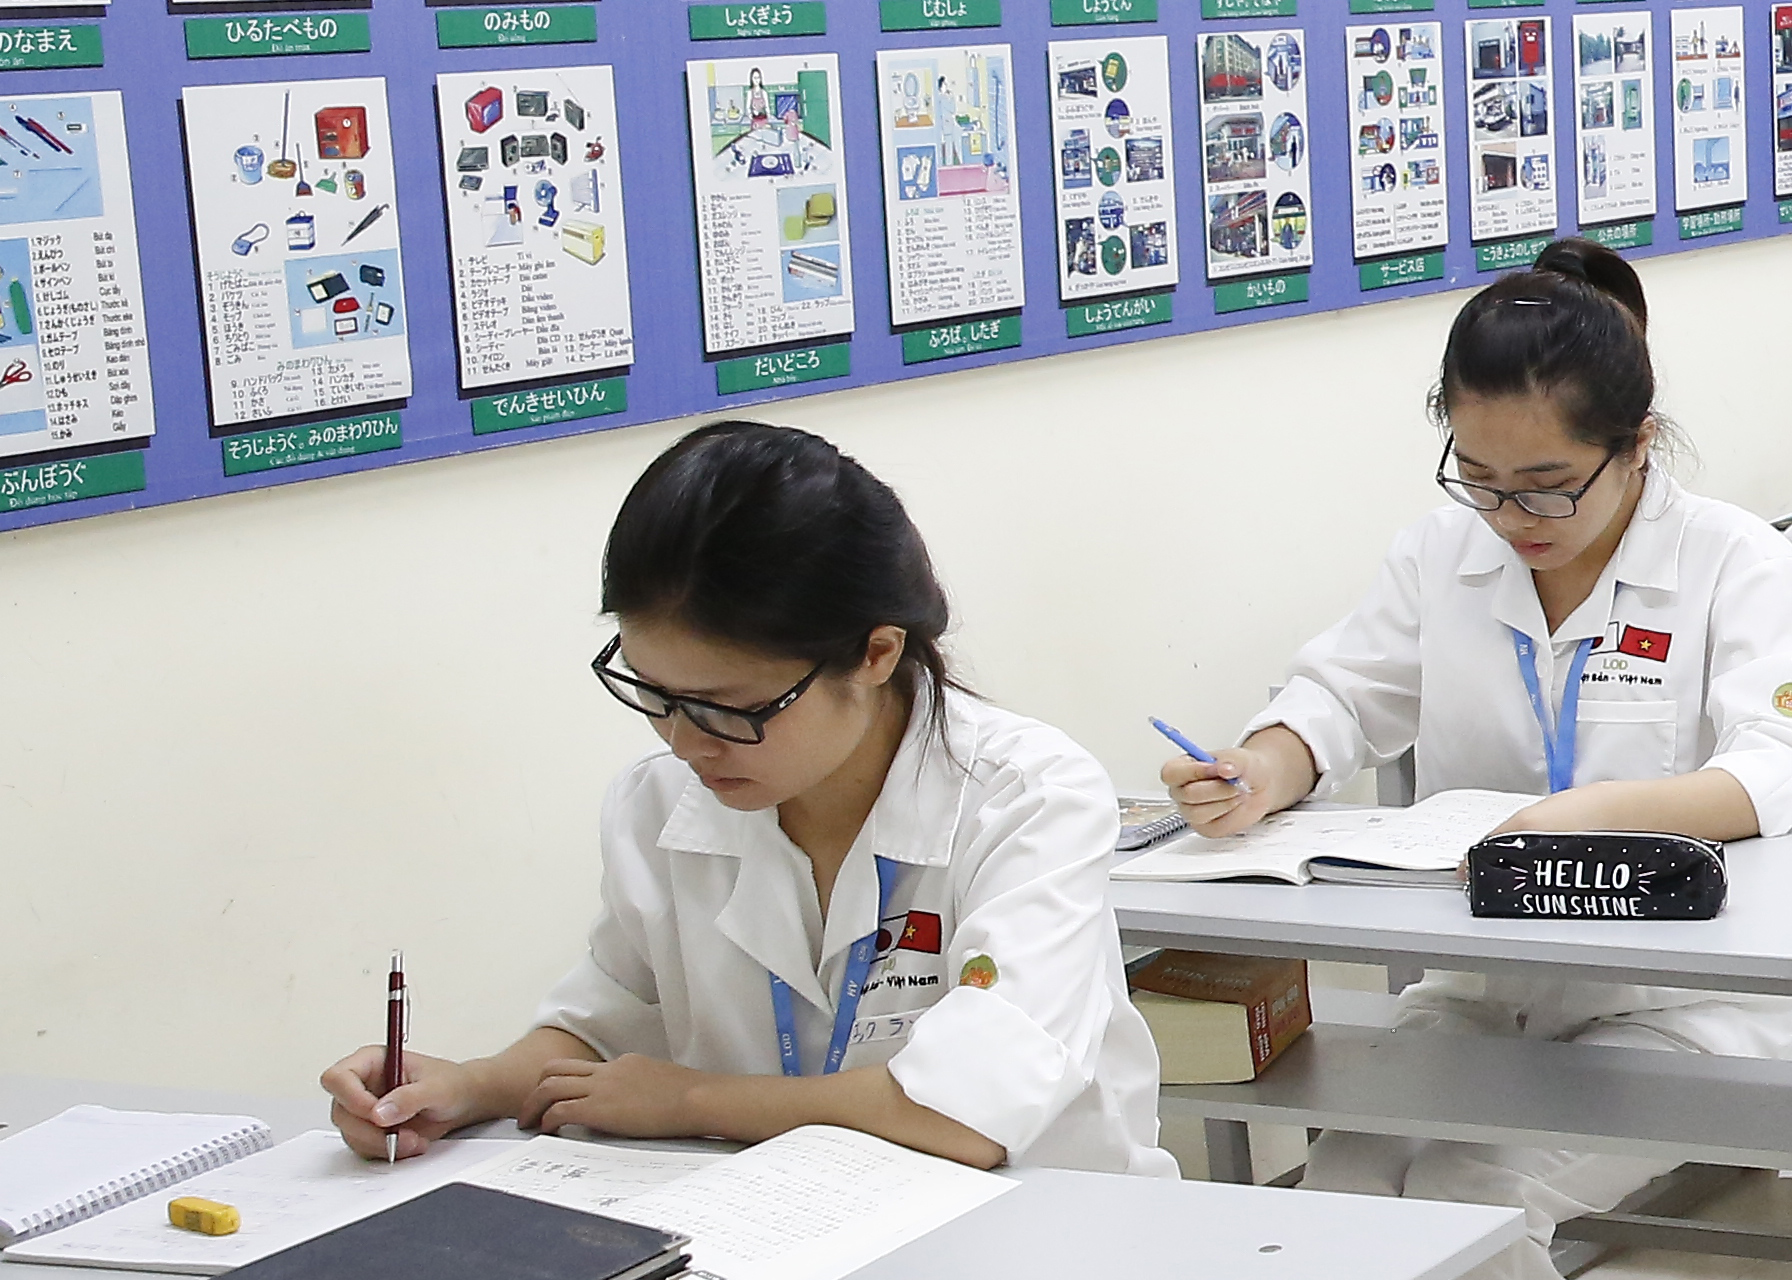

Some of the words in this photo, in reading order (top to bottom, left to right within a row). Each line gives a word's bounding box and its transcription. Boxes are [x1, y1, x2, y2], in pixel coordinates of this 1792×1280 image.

[484, 10, 550, 31] のみもの
[725, 4, 793, 27] しょくぎょう
[225, 17, 338, 42] ひるたべもの
[1380, 259, 1426, 277] サービス店
[1246, 279, 1287, 298] かいもの
[1084, 296, 1157, 323] しょうてんがい
[755, 350, 820, 376] だいどころ
[493, 383, 605, 416] でんきせいひん
[1, 462, 87, 496] ぶんぼうぐ
[1602, 658, 1629, 671] LOD
[1618, 673, 1638, 686] Việt
[1640, 676, 1663, 686] Nam
[1534, 859, 1632, 890] HELLO
[1522, 893, 1646, 917] SUNSHINE
[908, 974, 939, 987] Nam
